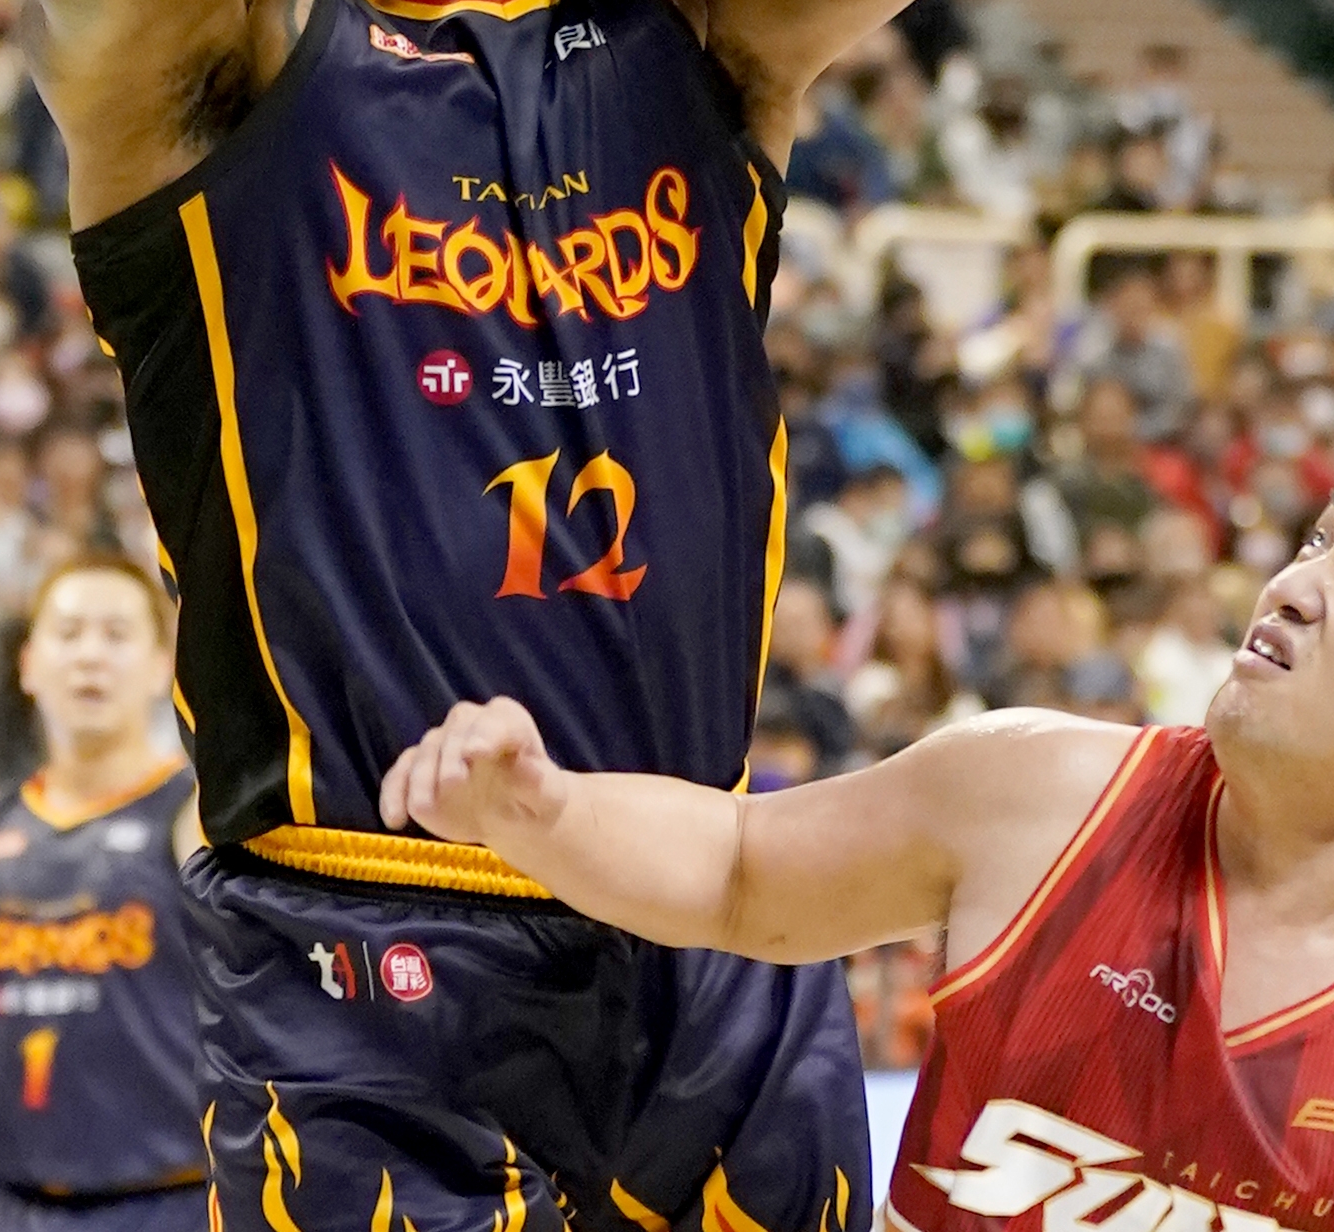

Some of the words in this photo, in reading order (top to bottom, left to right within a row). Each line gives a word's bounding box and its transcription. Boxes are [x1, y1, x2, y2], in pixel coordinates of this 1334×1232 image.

[491, 347, 642, 409] 永豐銀行
[481, 446, 649, 602] 12
[21, 1025, 60, 1111] 1
